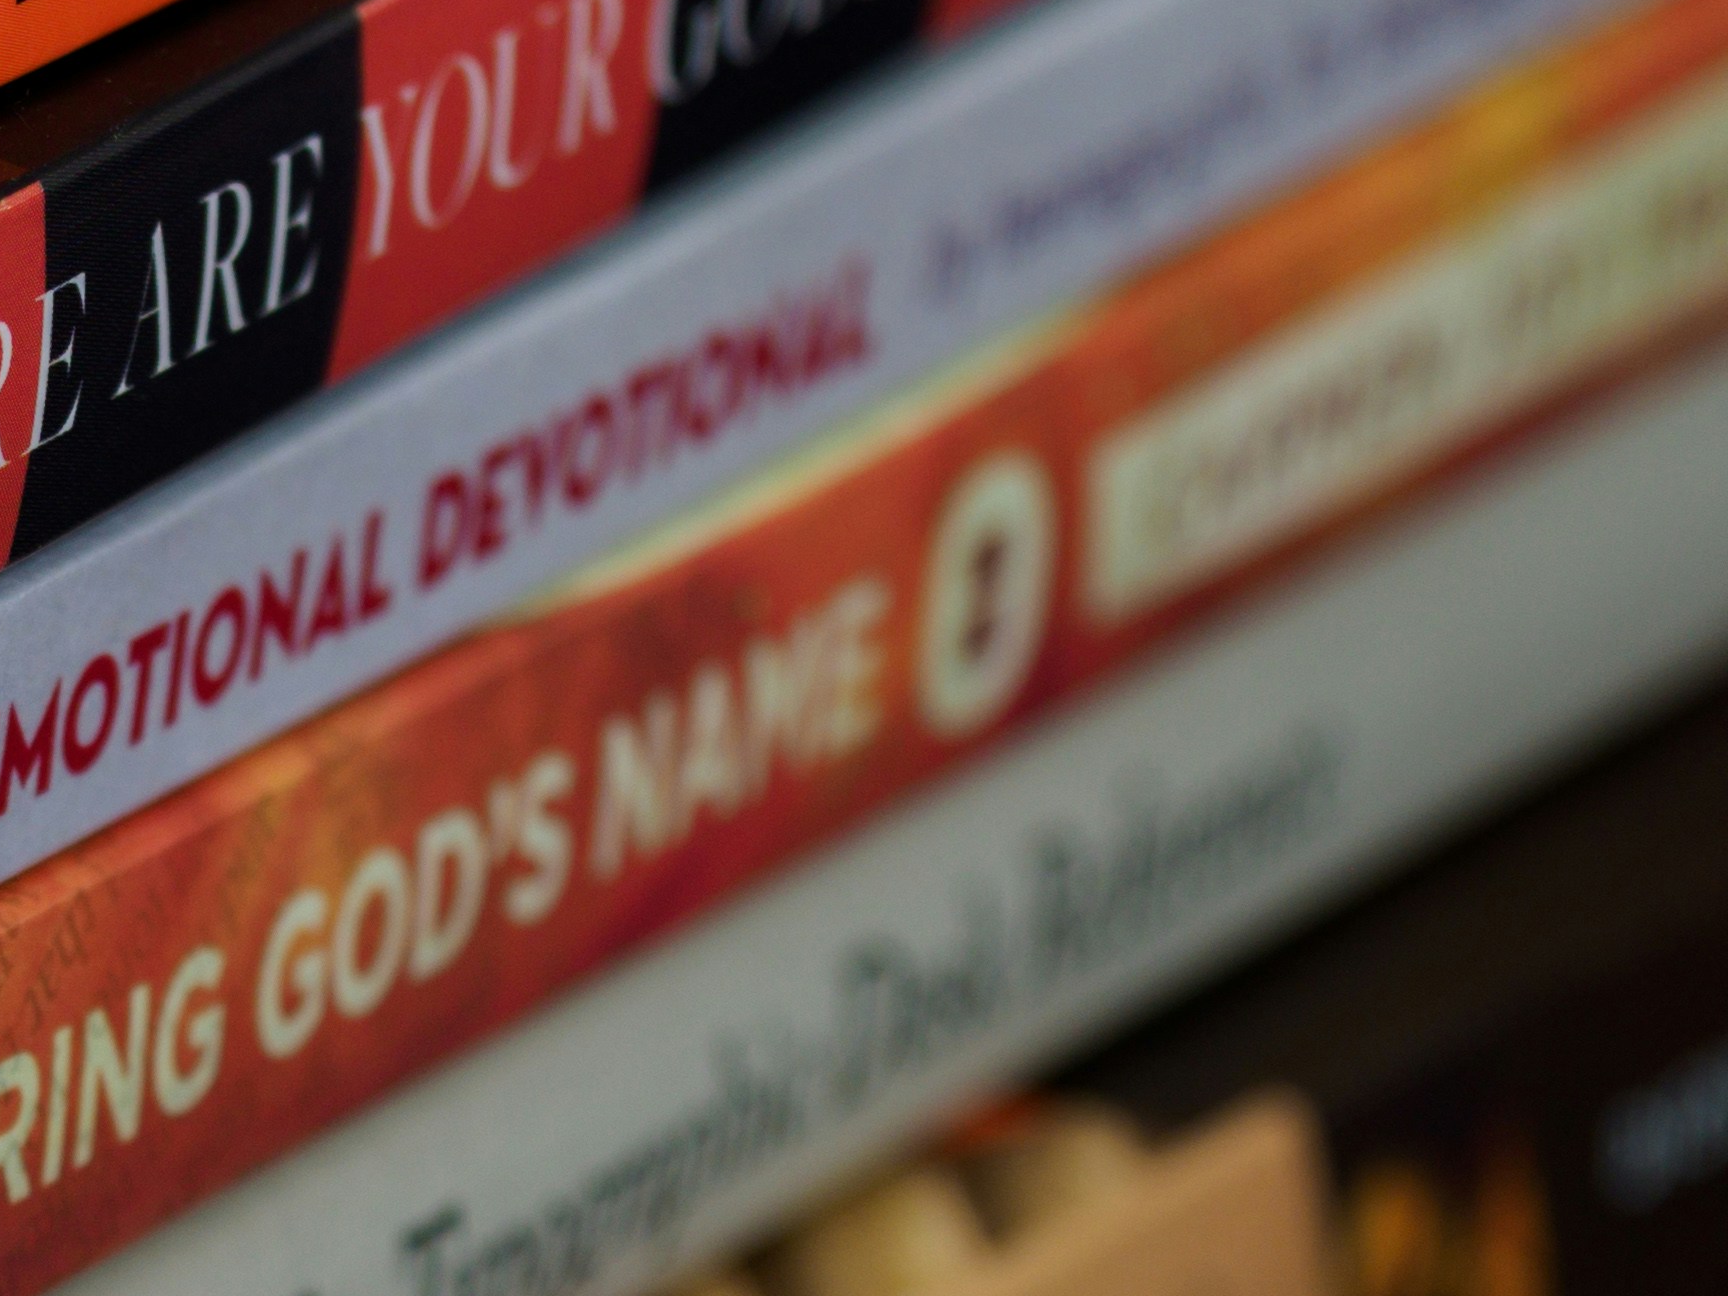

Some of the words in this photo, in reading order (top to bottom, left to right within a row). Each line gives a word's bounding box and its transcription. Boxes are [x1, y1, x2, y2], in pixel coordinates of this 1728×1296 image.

[109, 132, 326, 403] ARE
[412, 256, 880, 600] DEVOTIONAL
[253, 750, 578, 1062] GOD'S
[588, 572, 896, 884] NAME
